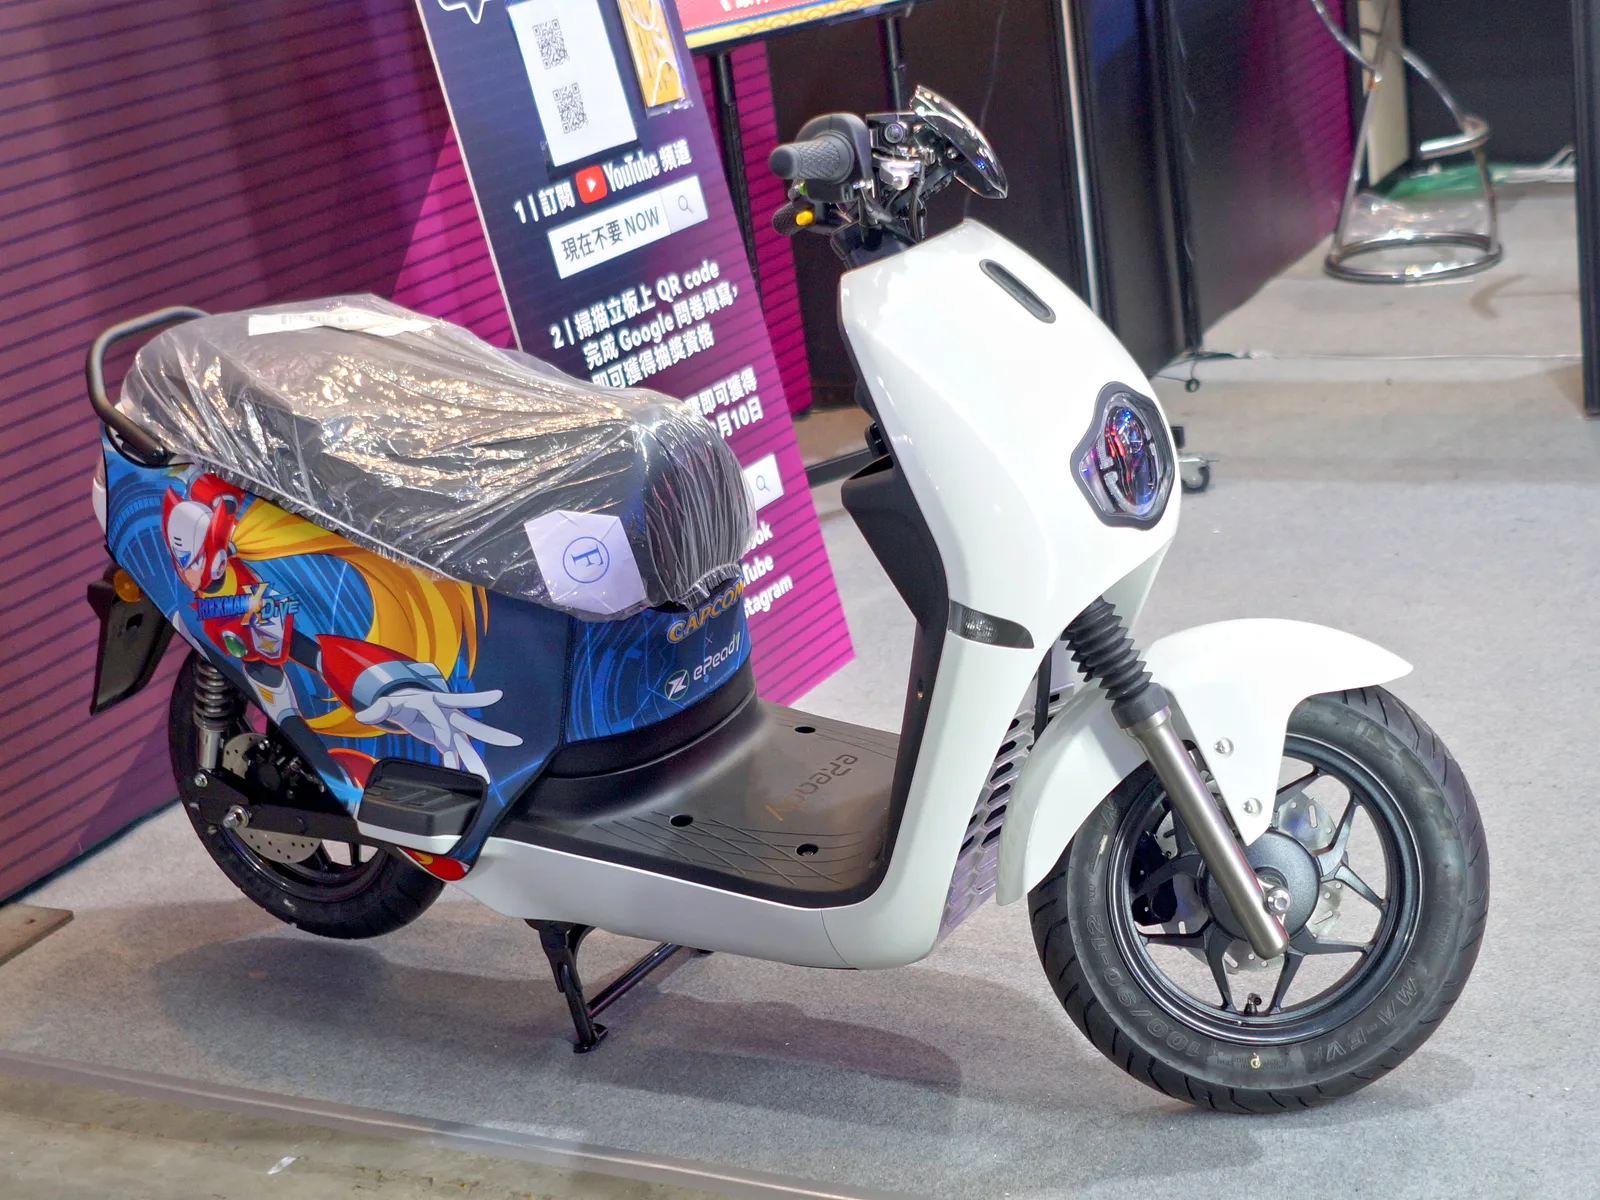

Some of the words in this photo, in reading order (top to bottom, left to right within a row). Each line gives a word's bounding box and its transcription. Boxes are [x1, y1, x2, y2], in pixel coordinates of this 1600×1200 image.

[603, 150, 660, 192] YouTube
[659, 138, 692, 172] 頻道
[561, 219, 623, 262] 現在不要
[624, 207, 660, 236] NOW
[656, 275, 682, 303] QR
[684, 260, 720, 290] code
[583, 332, 619, 370] 完成
[619, 313, 675, 351] Google
[667, 577, 745, 643] CAPCOM
[693, 631, 741, 681] eReady
